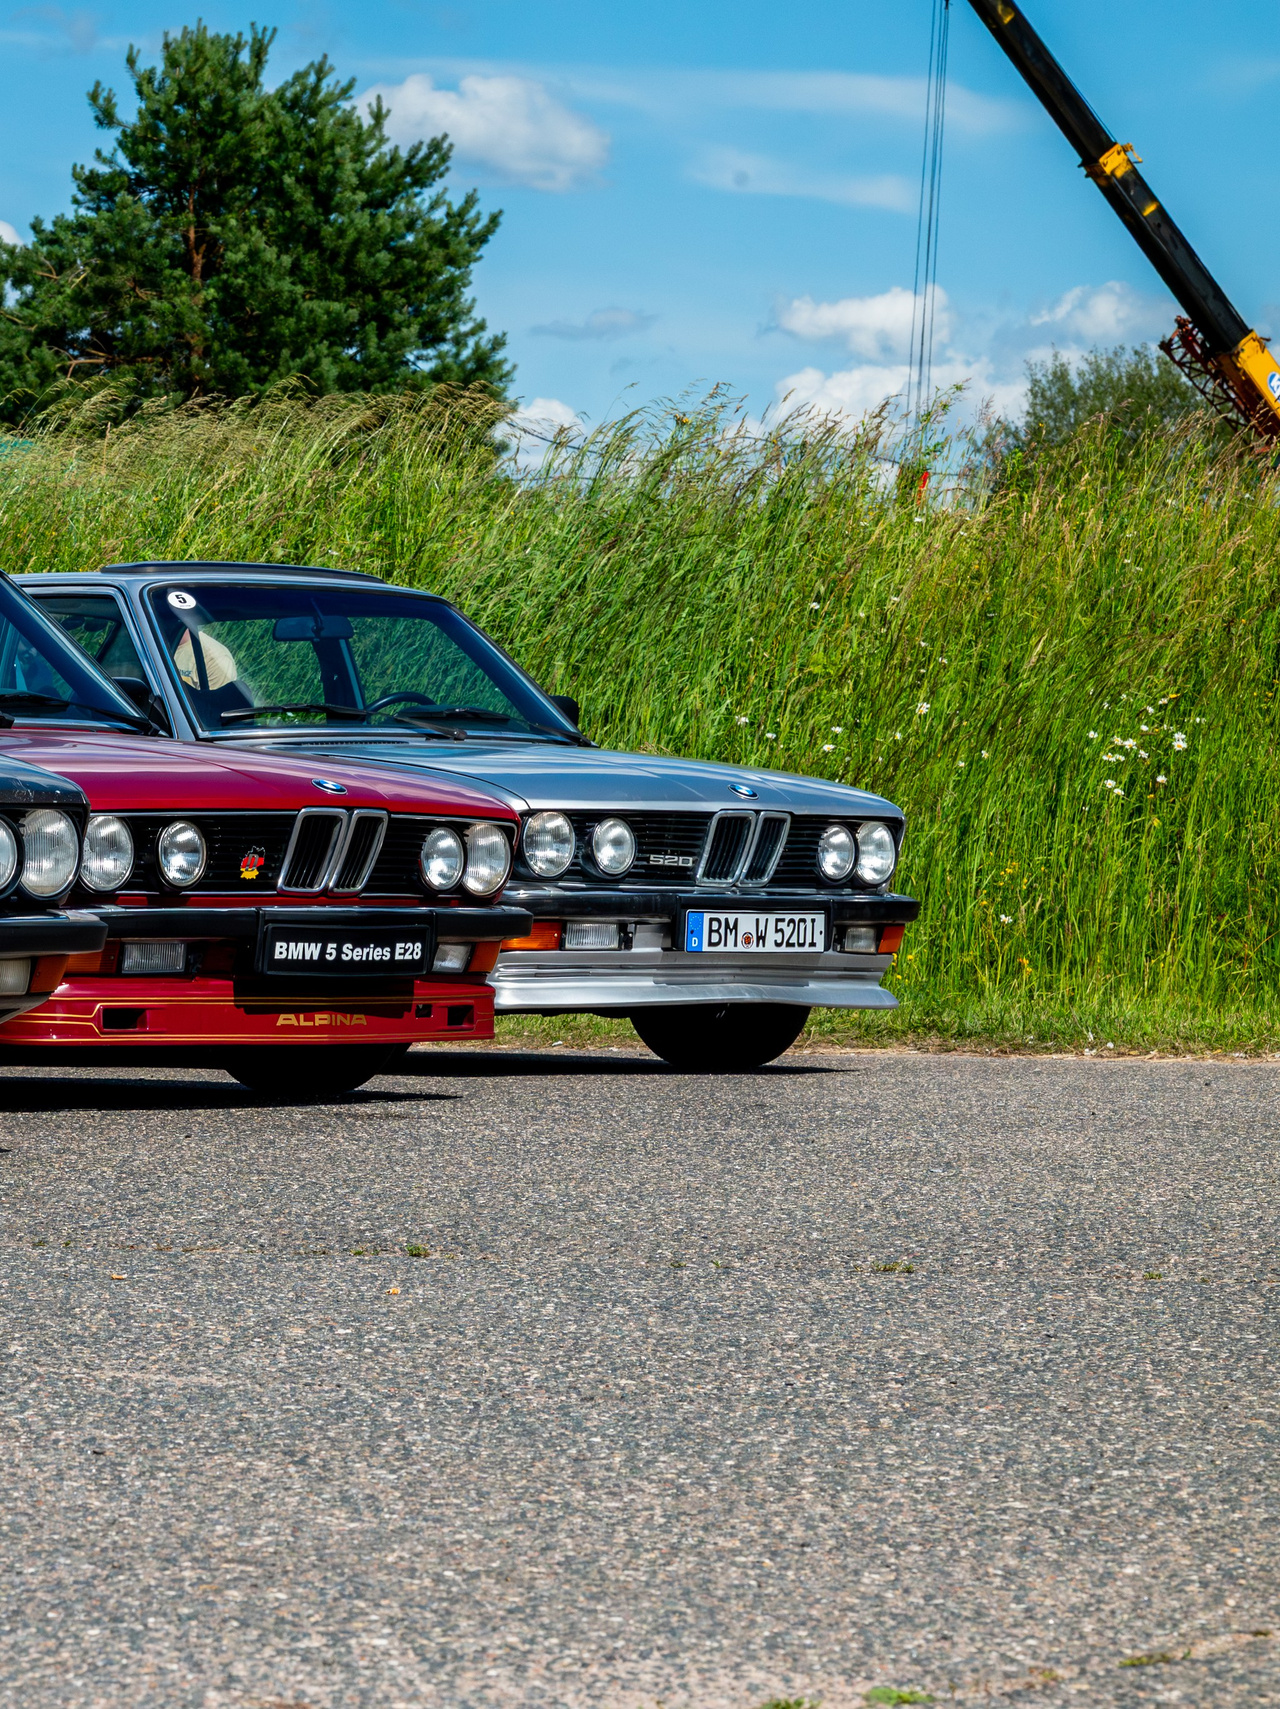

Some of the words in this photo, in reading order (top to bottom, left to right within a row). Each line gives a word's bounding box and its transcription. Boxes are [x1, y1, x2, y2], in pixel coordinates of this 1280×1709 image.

[174, 594, 187, 604] 5
[649, 854, 693, 867] 520
[707, 916, 739, 948] BM
[755, 917, 769, 948] W
[691, 936, 699, 947] D
[273, 941, 322, 961] BMW
[325, 943, 337, 961] 5
[341, 943, 391, 961] Series
[394, 942, 422, 961] E28
[275, 1013, 368, 1027] ALPINA
